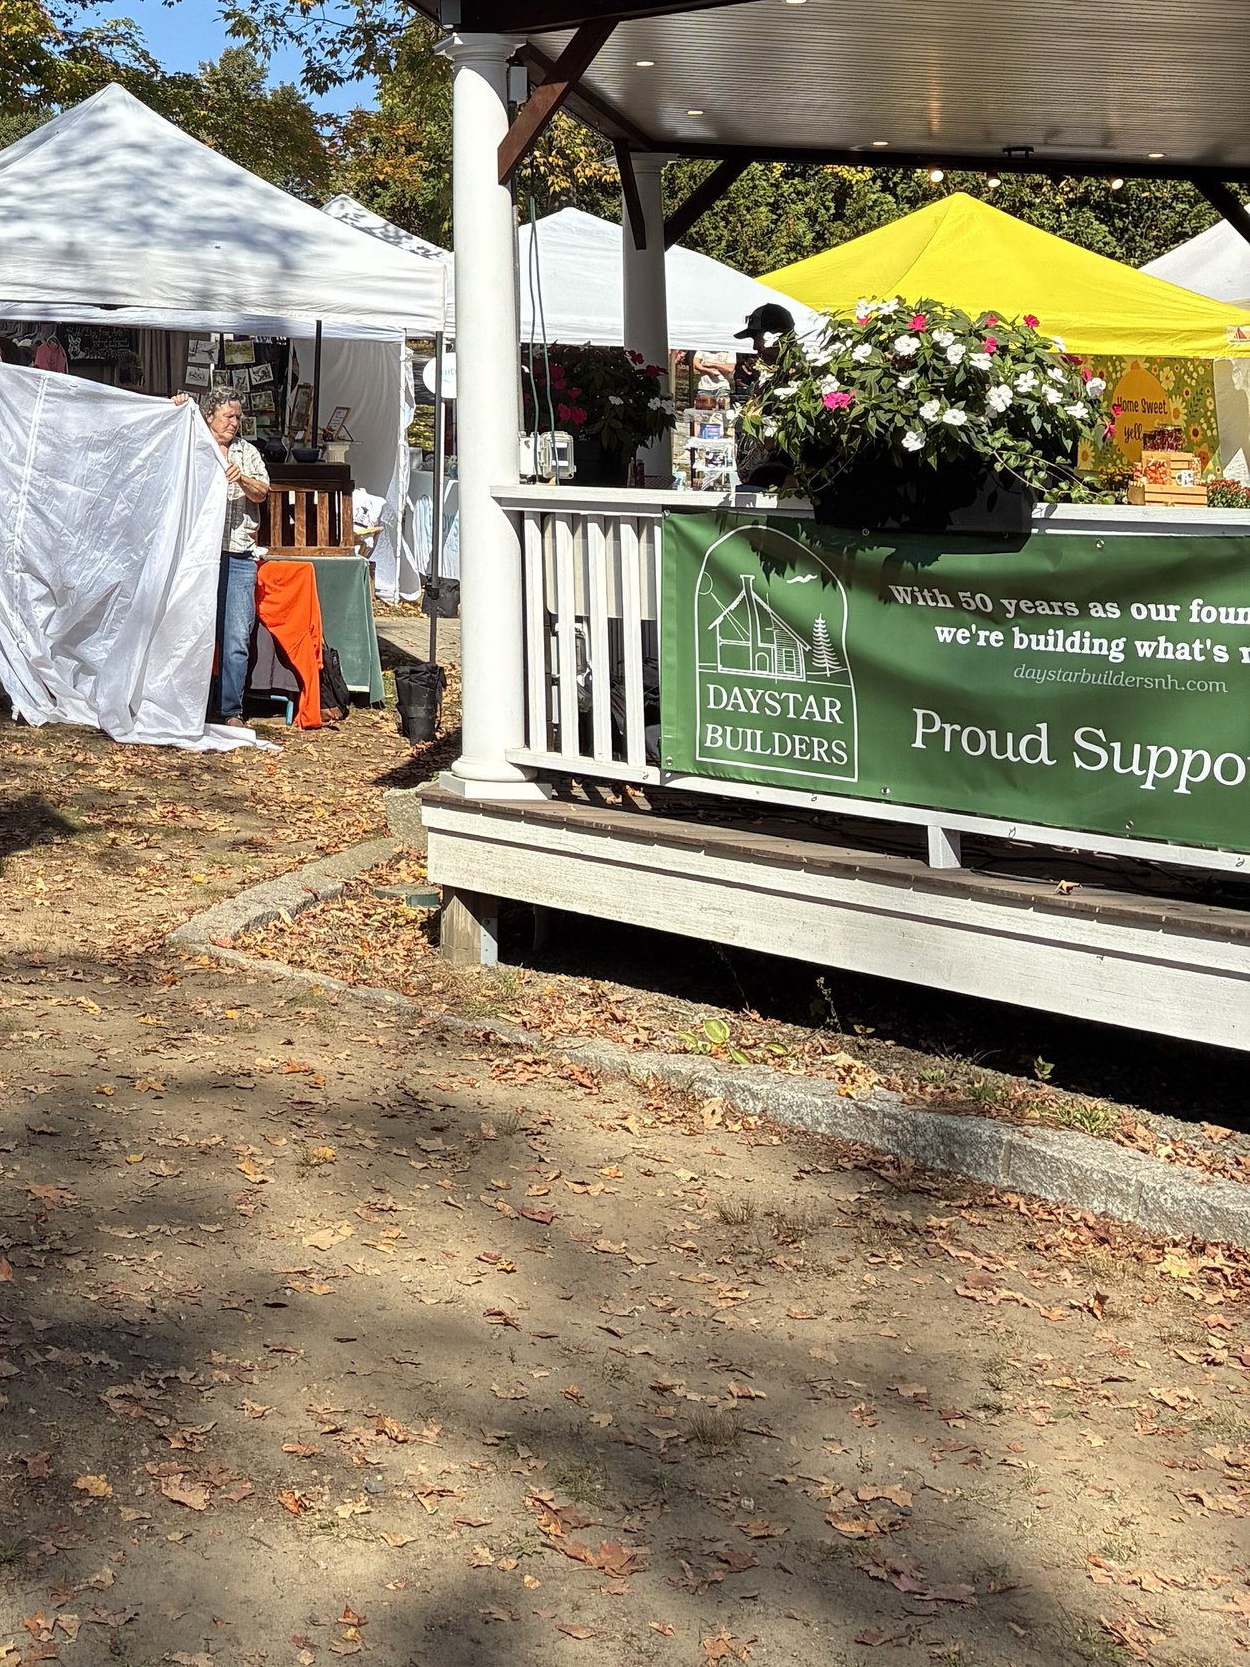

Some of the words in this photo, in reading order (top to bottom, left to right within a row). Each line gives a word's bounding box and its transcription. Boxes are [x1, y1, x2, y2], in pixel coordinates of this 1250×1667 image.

[1141, 397, 1168, 415] Sweet
[1124, 423, 1143, 443] yell
[888, 584, 954, 609] With
[958, 591, 993, 613] 50
[1000, 598, 1080, 619] years
[1088, 601, 1122, 619] as
[1130, 602, 1181, 622] our
[1189, 598, 1250, 625] foun
[934, 623, 1005, 648] we're
[1012, 626, 1127, 664] building
[1134, 635, 1230, 664] what's
[1013, 663, 1228, 693] daystarbuildersnh.com
[706, 683, 844, 724] DAYSTAR
[704, 723, 848, 765] BUILDERS
[911, 707, 1057, 766] Proud
[1072, 726, 1250, 795] Suppo
